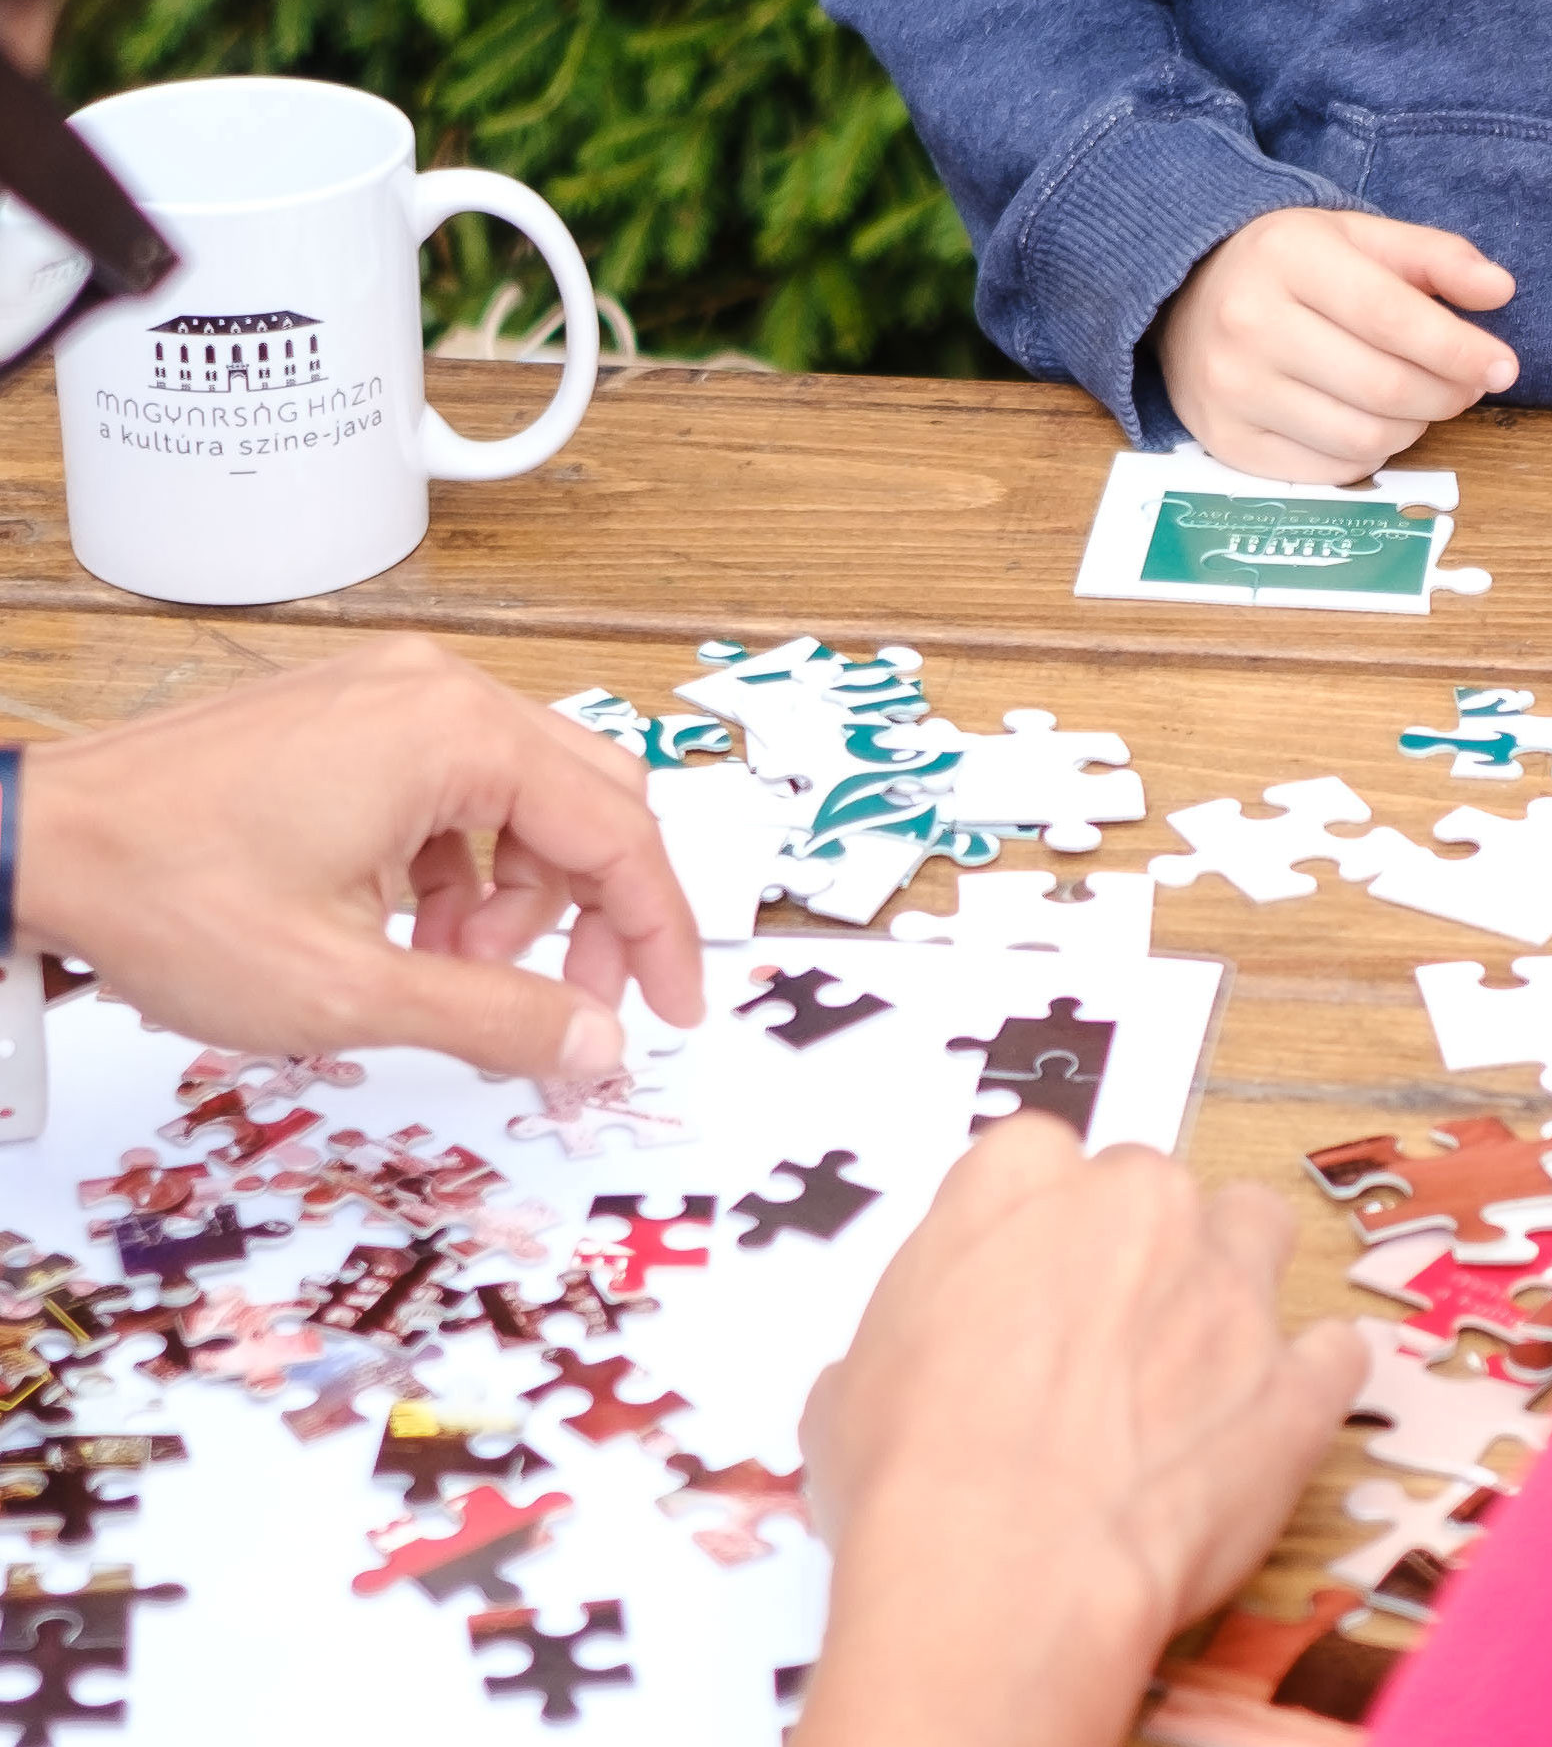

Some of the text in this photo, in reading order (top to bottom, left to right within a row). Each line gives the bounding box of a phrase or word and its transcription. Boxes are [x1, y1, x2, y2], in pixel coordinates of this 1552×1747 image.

[308, 376, 383, 418] HÁZA
[99, 421, 111, 439] a
[121, 424, 224, 456] kultúra
